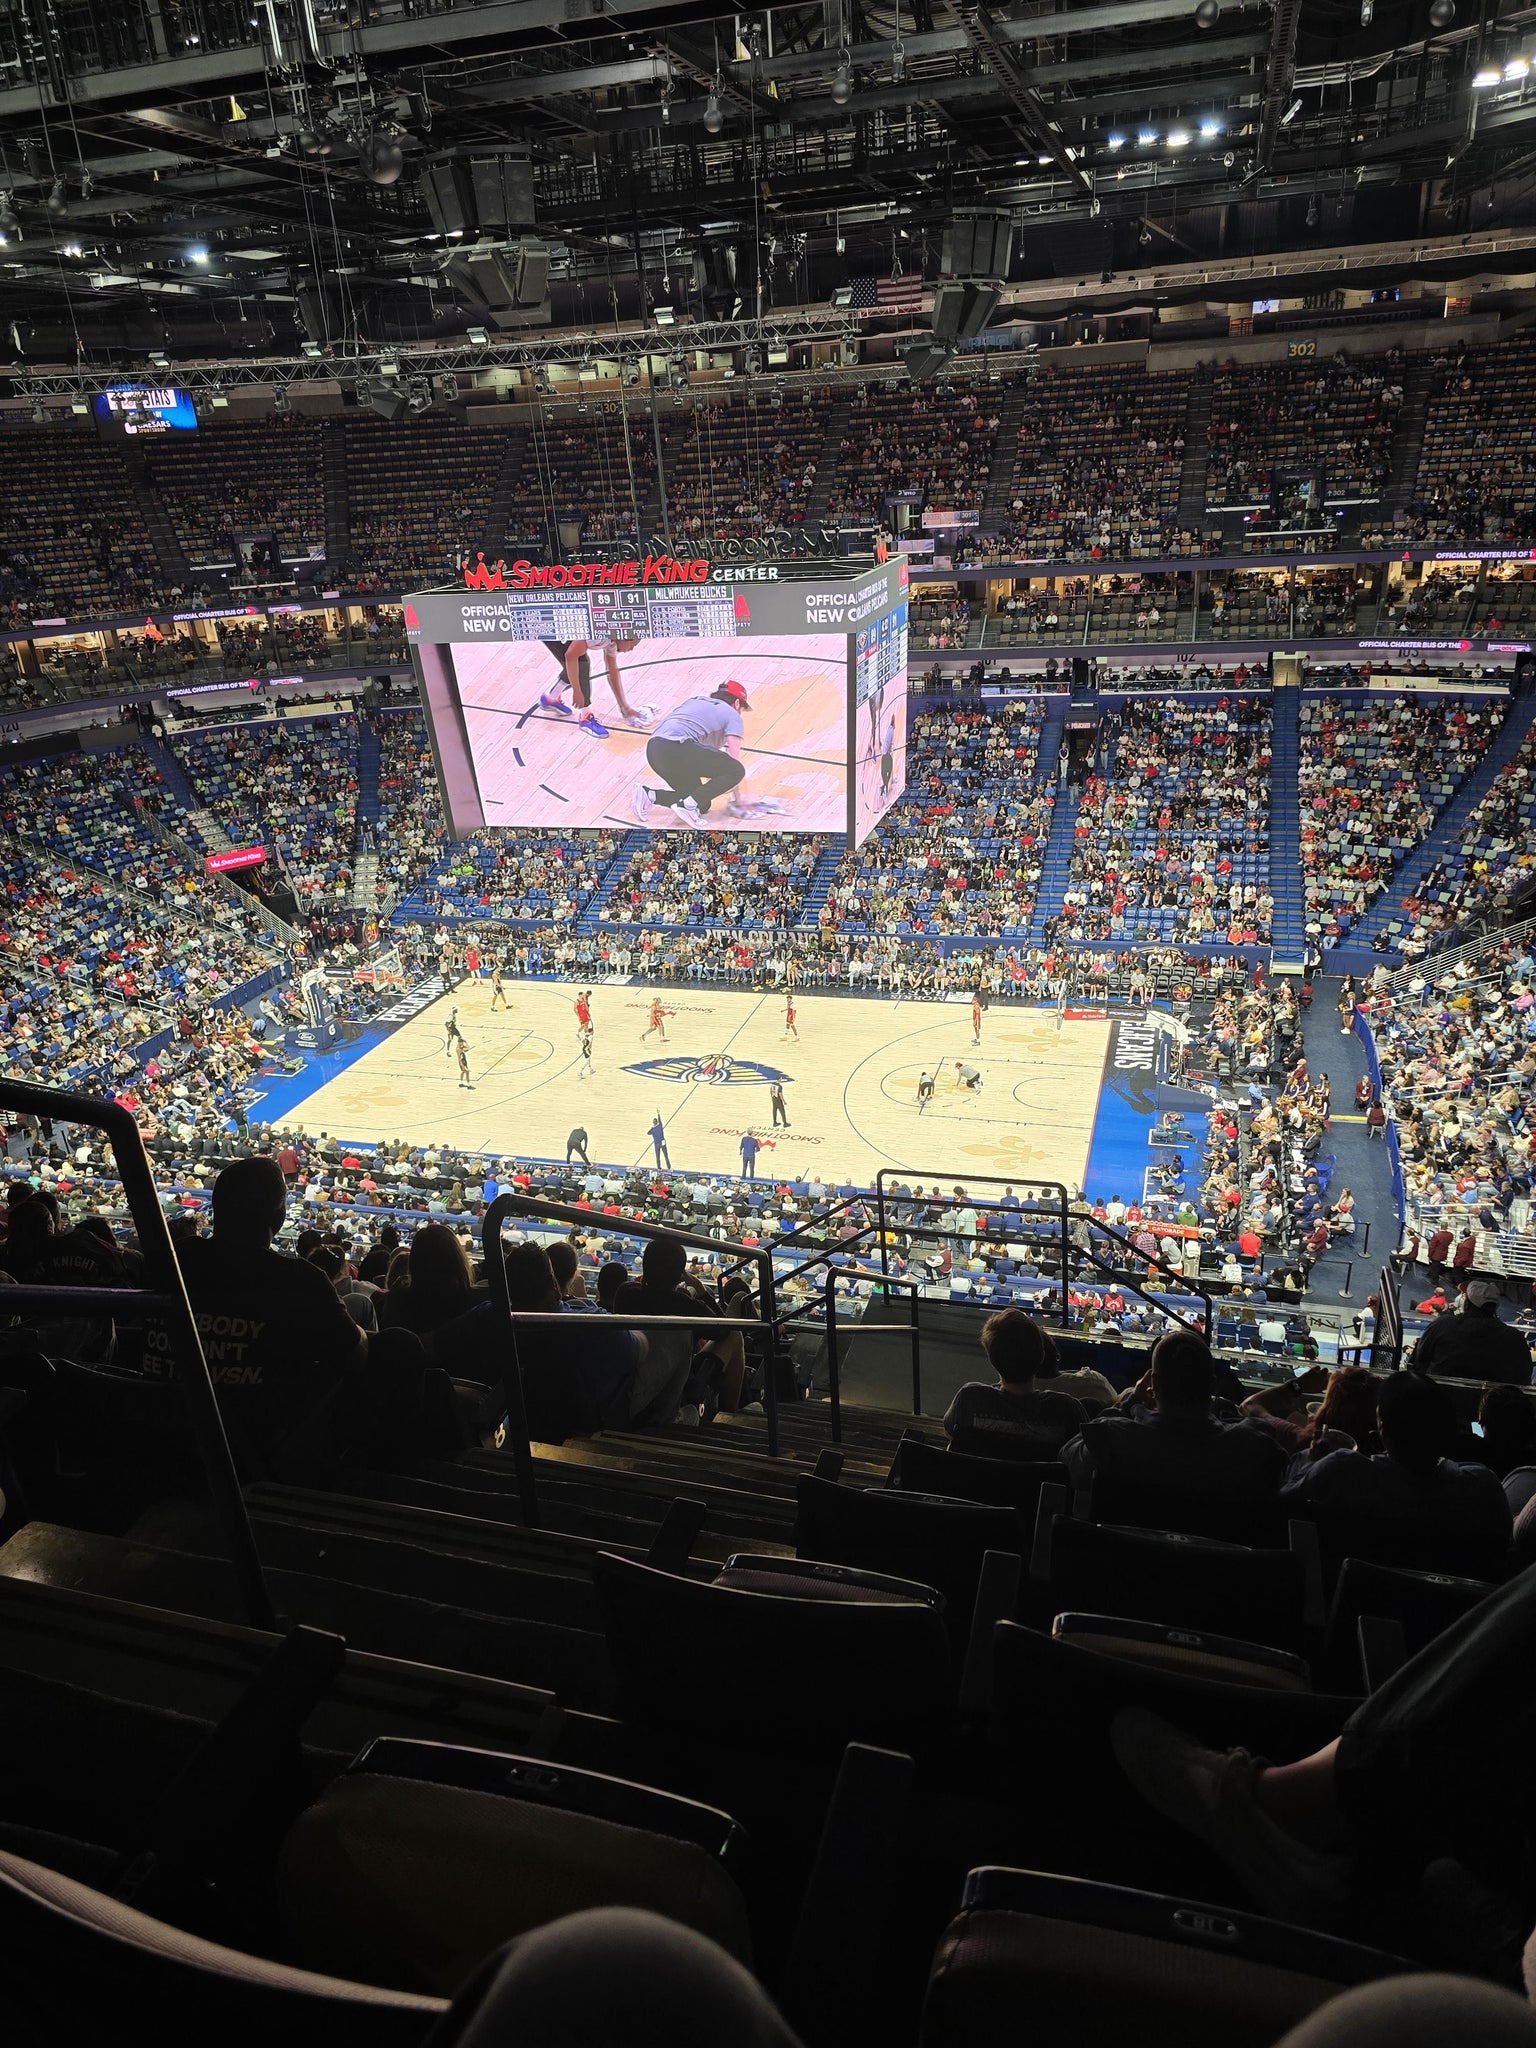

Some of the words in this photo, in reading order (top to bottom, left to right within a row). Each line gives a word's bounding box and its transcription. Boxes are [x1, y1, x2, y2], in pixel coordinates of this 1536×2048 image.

[1288, 343, 1316, 357] 302
[1435, 551, 1464, 560] OFFICIAL
[1465, 551, 1502, 559] CHARTER
[1502, 551, 1517, 559] BUS
[1518, 550, 1528, 558] OF
[511, 559, 641, 588] SMOOTHIE
[713, 566, 779, 582] CENTER
[509, 594, 524, 603] NEW
[525, 593, 554, 602] ORLEANS
[555, 592, 587, 602] PELICANS
[597, 594, 610, 604] 89
[627, 590, 639, 603] 91
[655, 588, 700, 600] MILWAUKEE
[701, 586, 727, 599] BUCKS
[173, 612, 198, 622] OFFICIAL
[198, 609, 225, 619] CHARTER
[225, 608, 236, 616] BUS
[236, 607, 244, 615] OF
[461, 605, 511, 617] OFFICIAL
[611, 611, 630, 620] 4:12
[806, 608, 844, 623] NEW
[463, 619, 496, 632] NEW
[1359, 641, 1390, 649] OFFICIAL
[1390, 641, 1422, 649] CHARTER
[166, 687, 188, 697] OFFICIAL
[188, 685, 217, 695] CHARTER
[217, 684, 229, 692] BUS
[229, 682, 238, 691] OF
[1151, 1226, 1185, 1235] GATORADE
